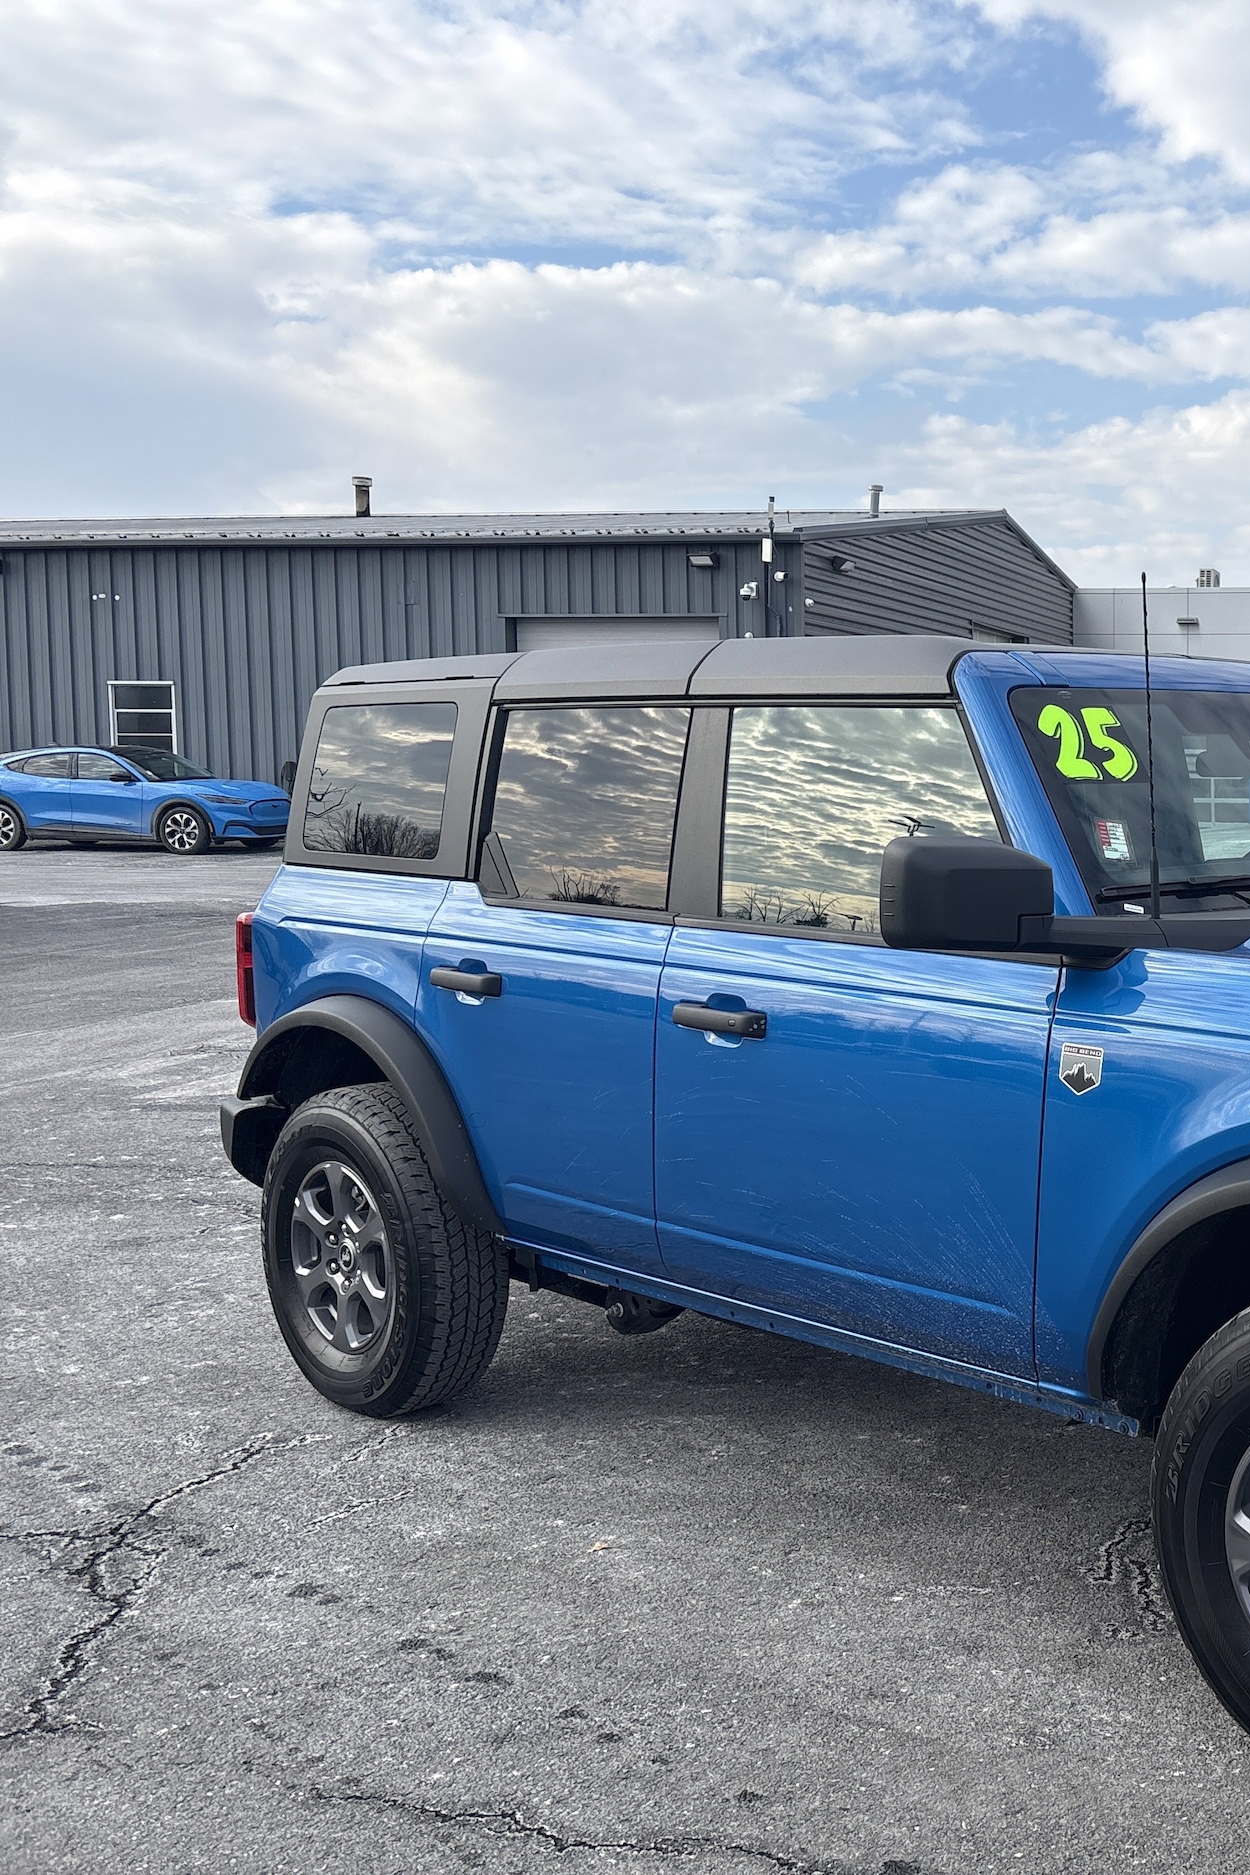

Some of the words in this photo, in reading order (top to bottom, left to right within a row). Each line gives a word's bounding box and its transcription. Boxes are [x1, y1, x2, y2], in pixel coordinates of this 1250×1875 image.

[1038, 704, 1139, 782] 25
[1064, 1045, 1079, 1053] BIG
[1079, 1048, 1102, 1057] BEND
